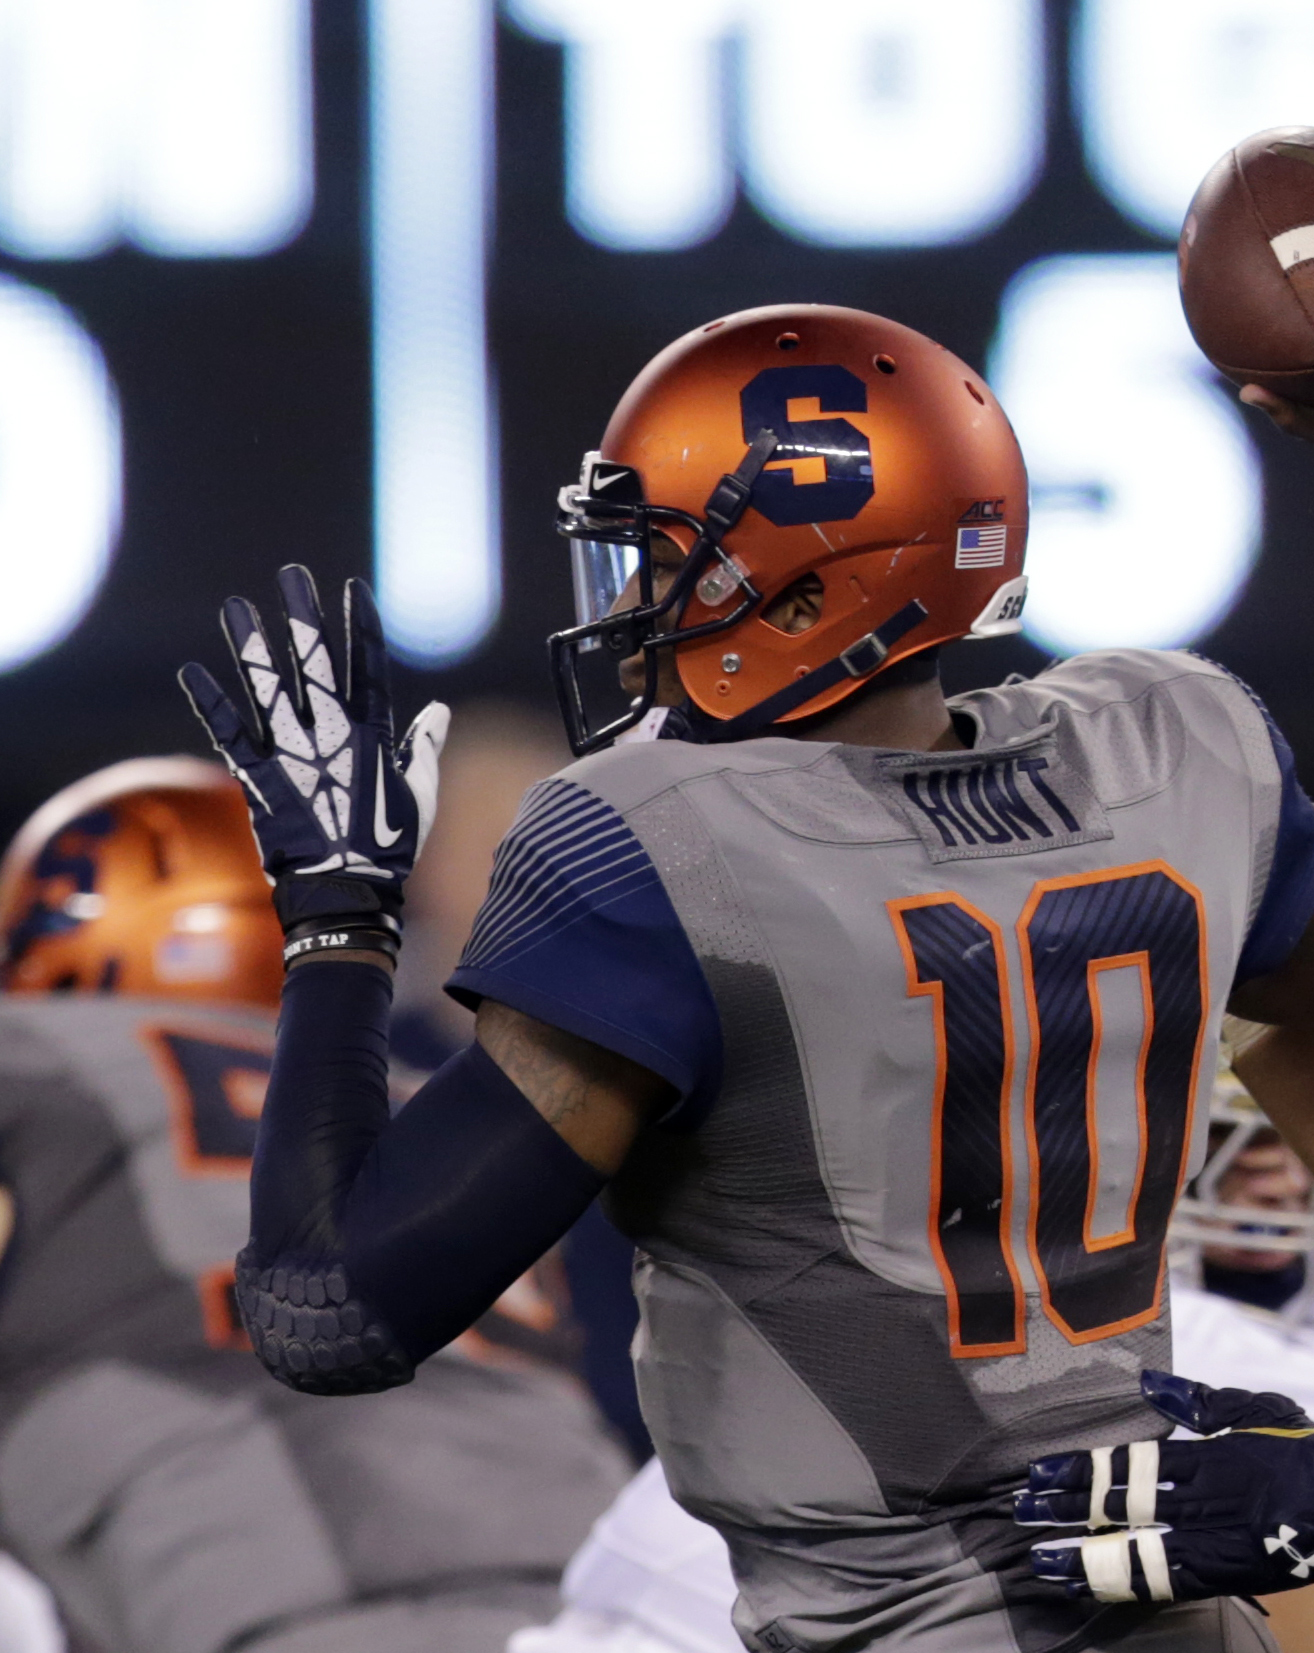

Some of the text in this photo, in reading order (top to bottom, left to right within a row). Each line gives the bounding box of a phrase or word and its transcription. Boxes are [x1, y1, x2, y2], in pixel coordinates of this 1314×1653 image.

[740, 364, 876, 528] S
[957, 499, 1004, 523] ACC
[903, 757, 1081, 847] HUNT
[318, 933, 349, 947] TAP
[885, 859, 1209, 1358] 10
